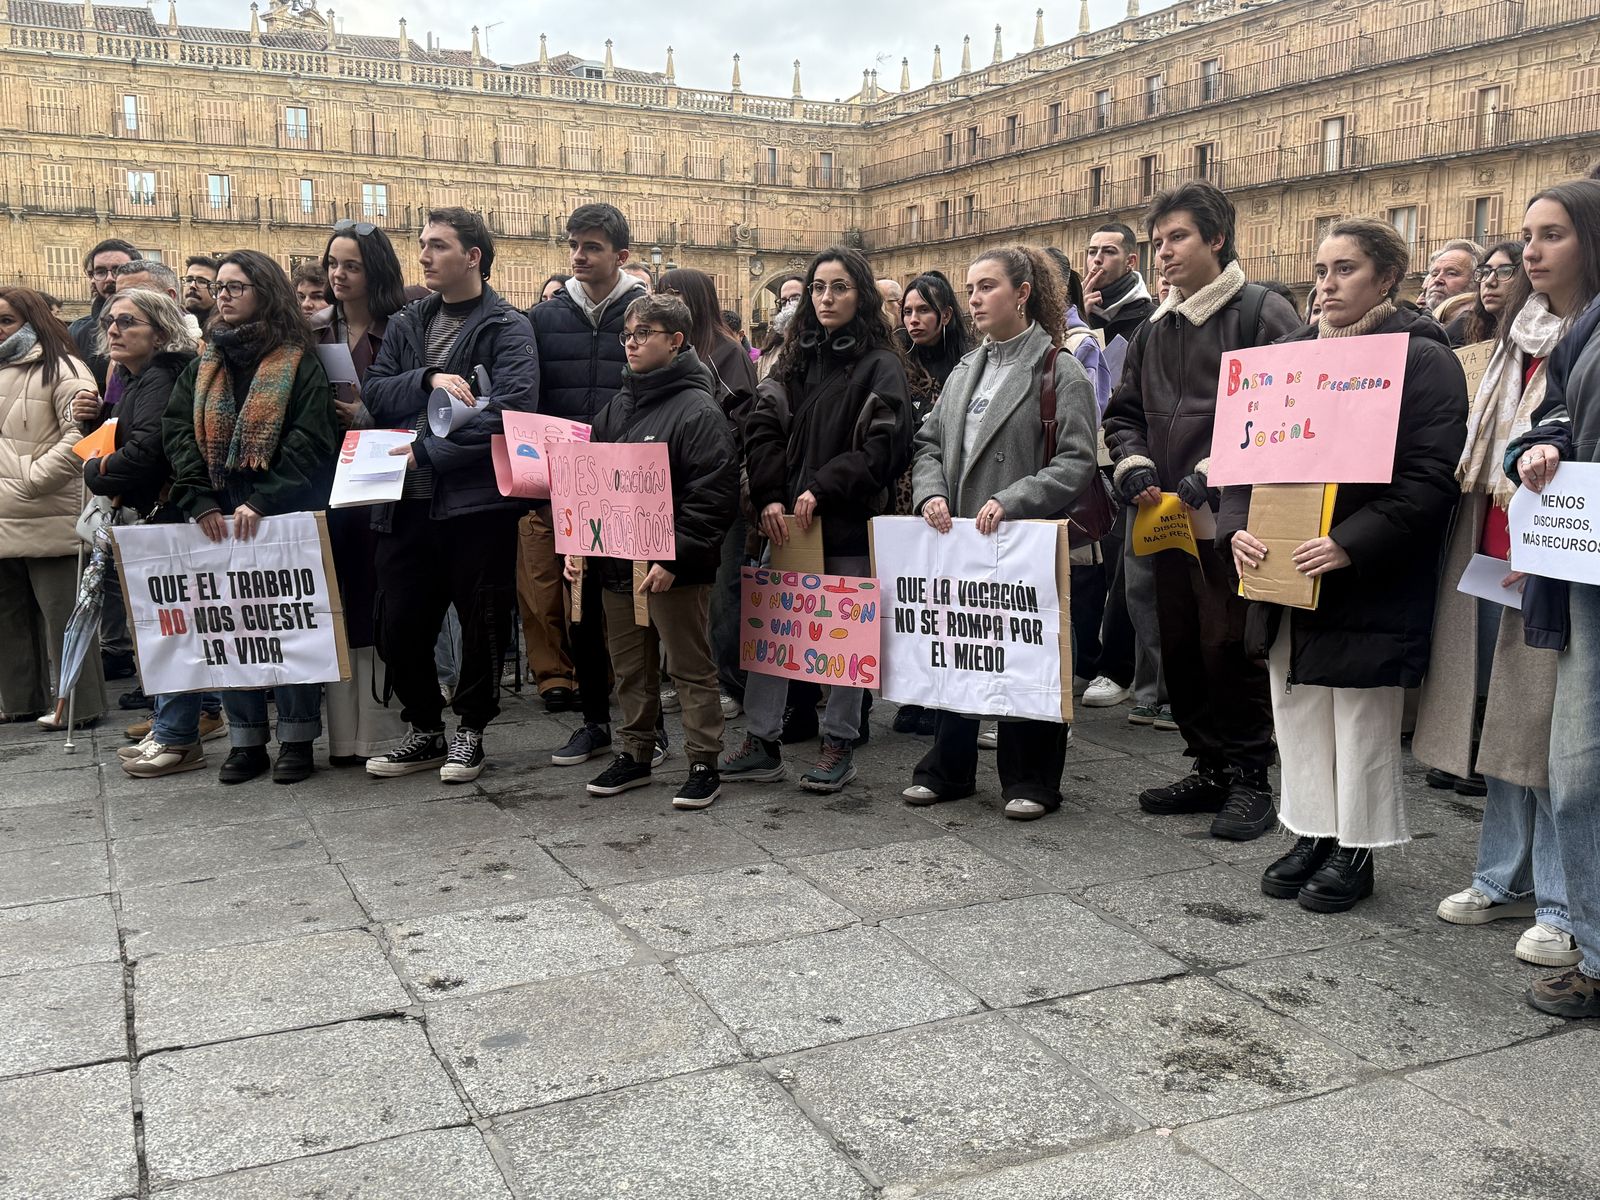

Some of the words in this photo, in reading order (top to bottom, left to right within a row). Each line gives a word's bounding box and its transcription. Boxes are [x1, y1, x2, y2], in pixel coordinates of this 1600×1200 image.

[1286, 371, 1302, 385] DE
[551, 455, 571, 497] NO
[574, 455, 599, 496] ES
[1541, 494, 1585, 510] MENOS
[557, 507, 572, 537] ES
[1160, 513, 1186, 523] MEN
[1533, 515, 1593, 533] DISCURSOS,
[1522, 531, 1540, 546] MÁS
[148, 574, 191, 605] QUE
[196, 571, 221, 600] EL
[226, 568, 316, 600] TRABAJO
[751, 592, 762, 607] A
[896, 577, 927, 604] QUE
[933, 578, 951, 605] LA
[957, 580, 1039, 613] VOCACIÓN
[769, 592, 832, 617] TOCAN
[838, 597, 876, 623] NOS
[158, 608, 188, 637] NO
[193, 605, 236, 634] NOS
[241, 602, 318, 632] CUESTE
[771, 618, 801, 638] UNA
[809, 621, 823, 641] A
[894, 607, 916, 634] NO
[920, 609, 940, 635] SE
[946, 611, 1004, 641] ROMPA
[1009, 616, 1044, 646] POR
[203, 639, 229, 666] LA
[234, 636, 284, 665] VIDA
[742, 639, 801, 671] TOCAN
[804, 648, 845, 679] NOS
[931, 641, 947, 668] EL
[954, 642, 1005, 673] MIEDO
